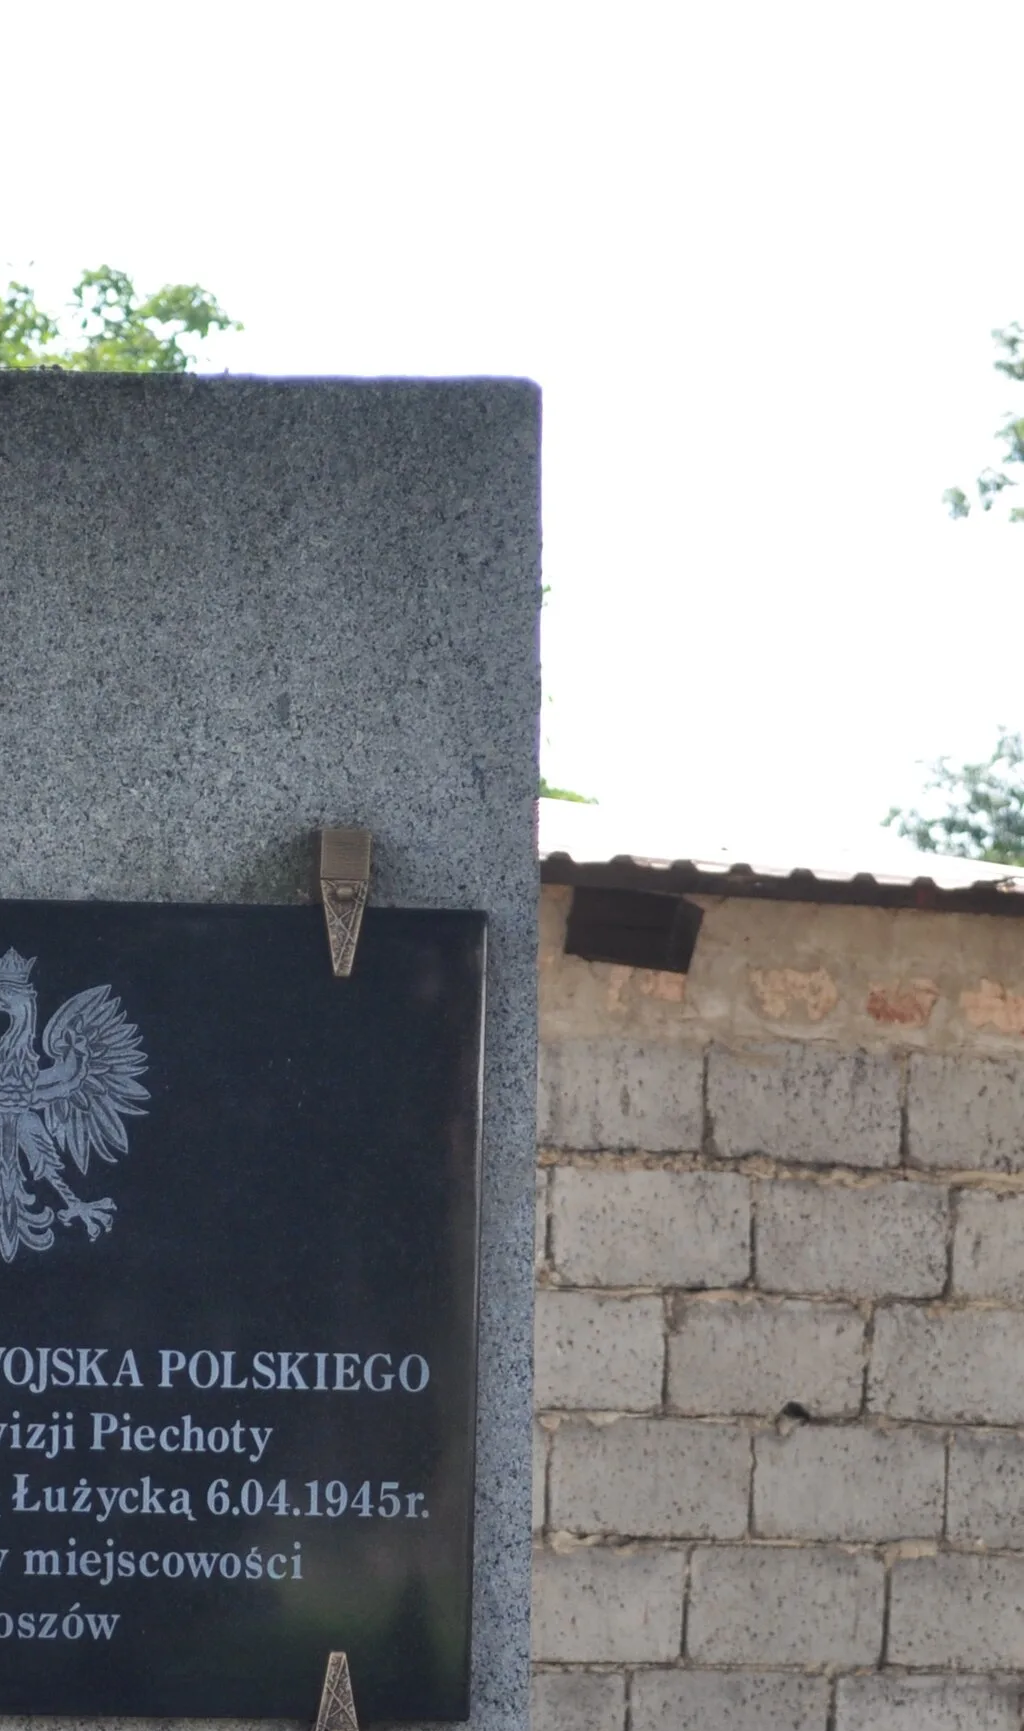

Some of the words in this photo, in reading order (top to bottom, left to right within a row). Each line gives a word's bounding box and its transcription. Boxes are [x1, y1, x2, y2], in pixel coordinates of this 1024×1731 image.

[157, 1349, 430, 1393] POLSKIEGO
[89, 1412, 274, 1463] Piechoty
[11, 1473, 197, 1523] Łużycką
[206, 1478, 430, 1519] 6.04.1945r.
[23, 1537, 304, 1586] miejscowości
